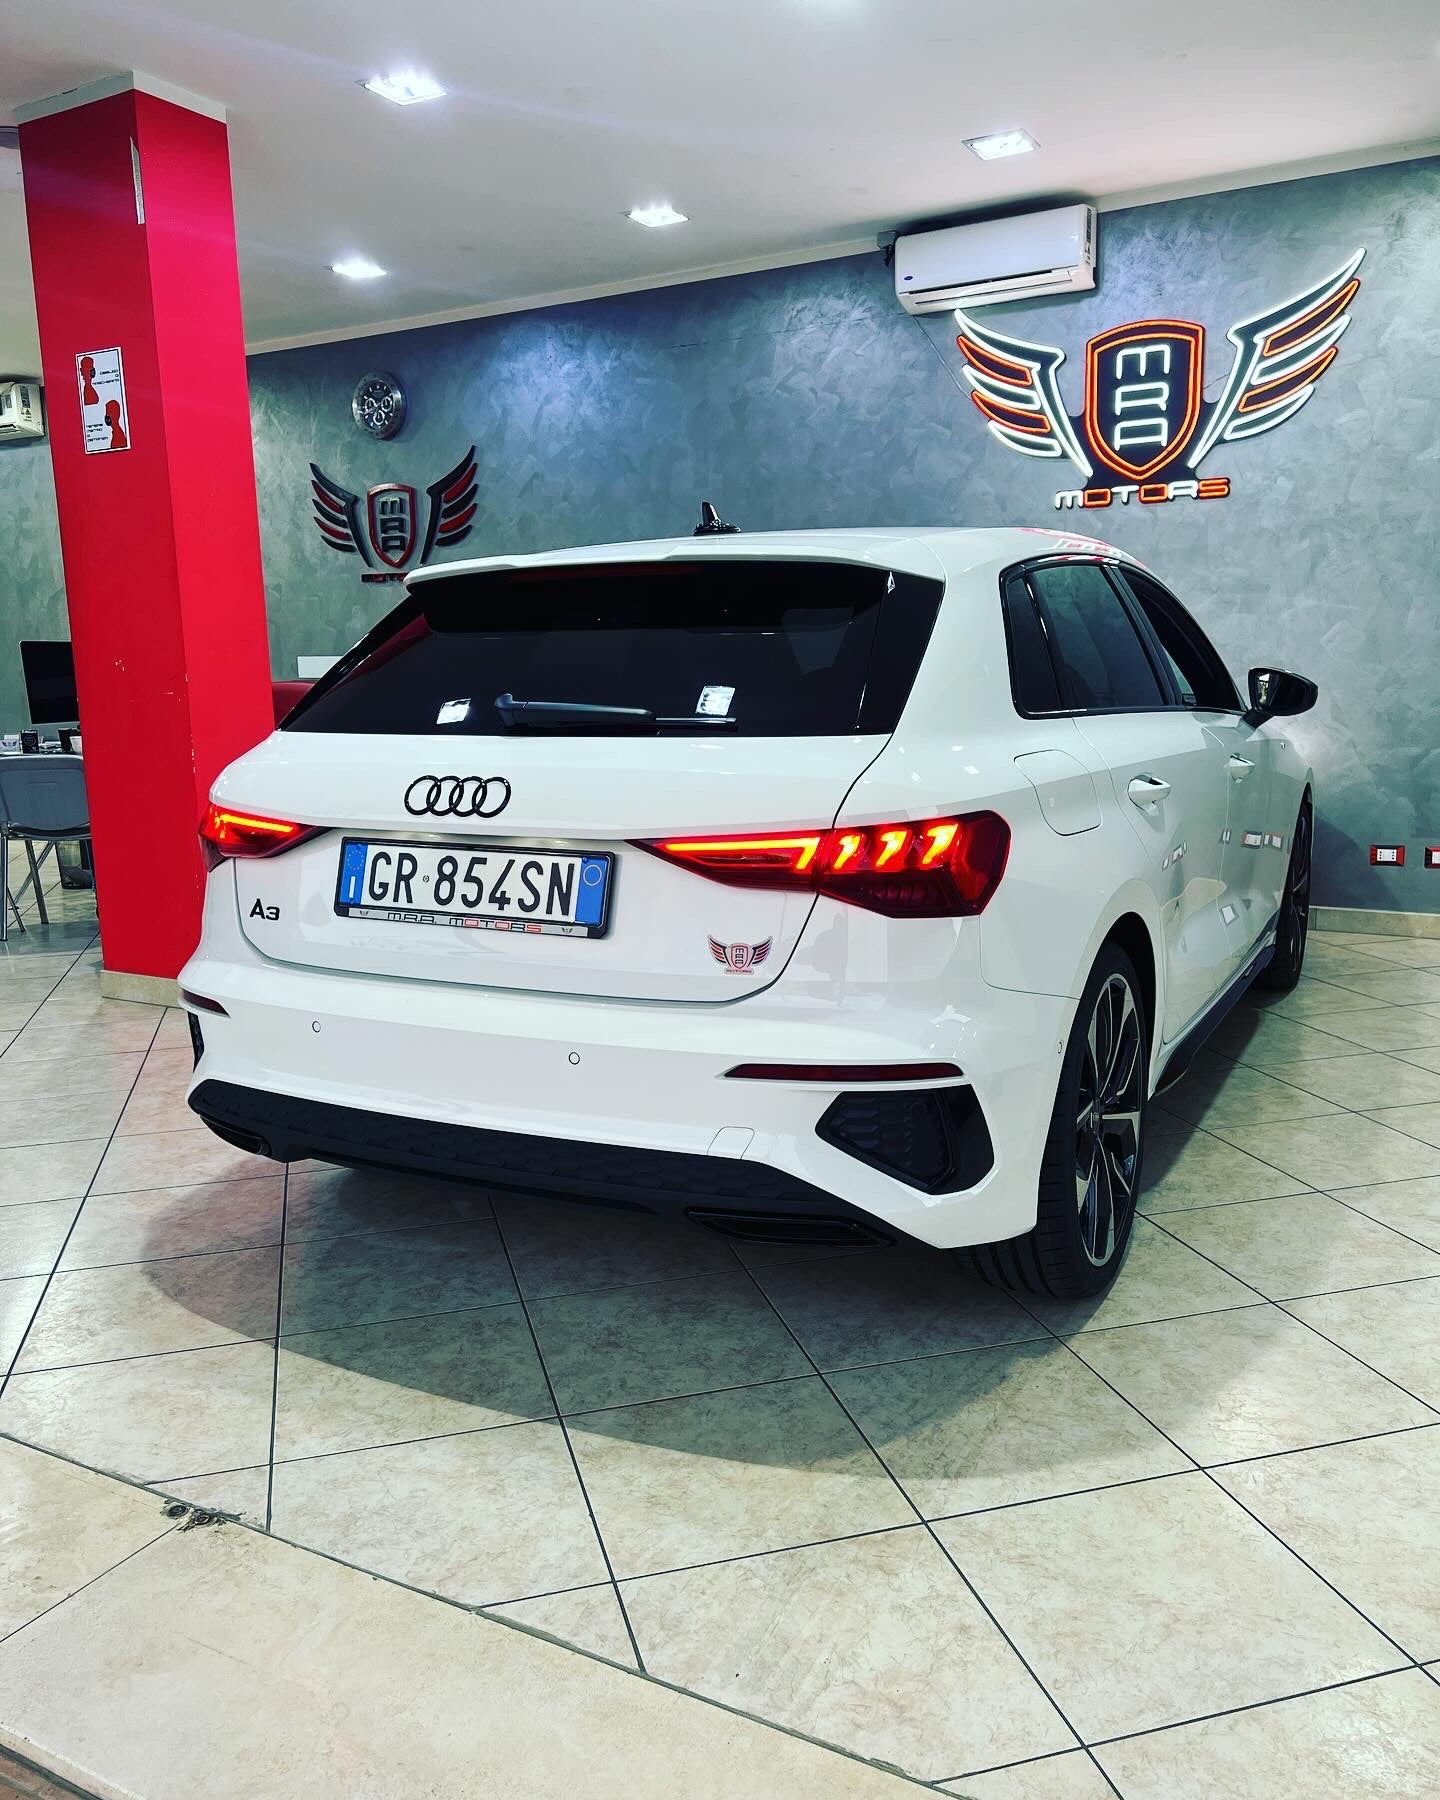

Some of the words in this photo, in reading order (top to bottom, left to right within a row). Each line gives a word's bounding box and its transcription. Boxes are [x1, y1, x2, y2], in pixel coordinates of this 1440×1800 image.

[1055, 477, 1231, 510] MOTORS
[249, 898, 280, 921] A3
[449, 917, 542, 933] MOTORS
